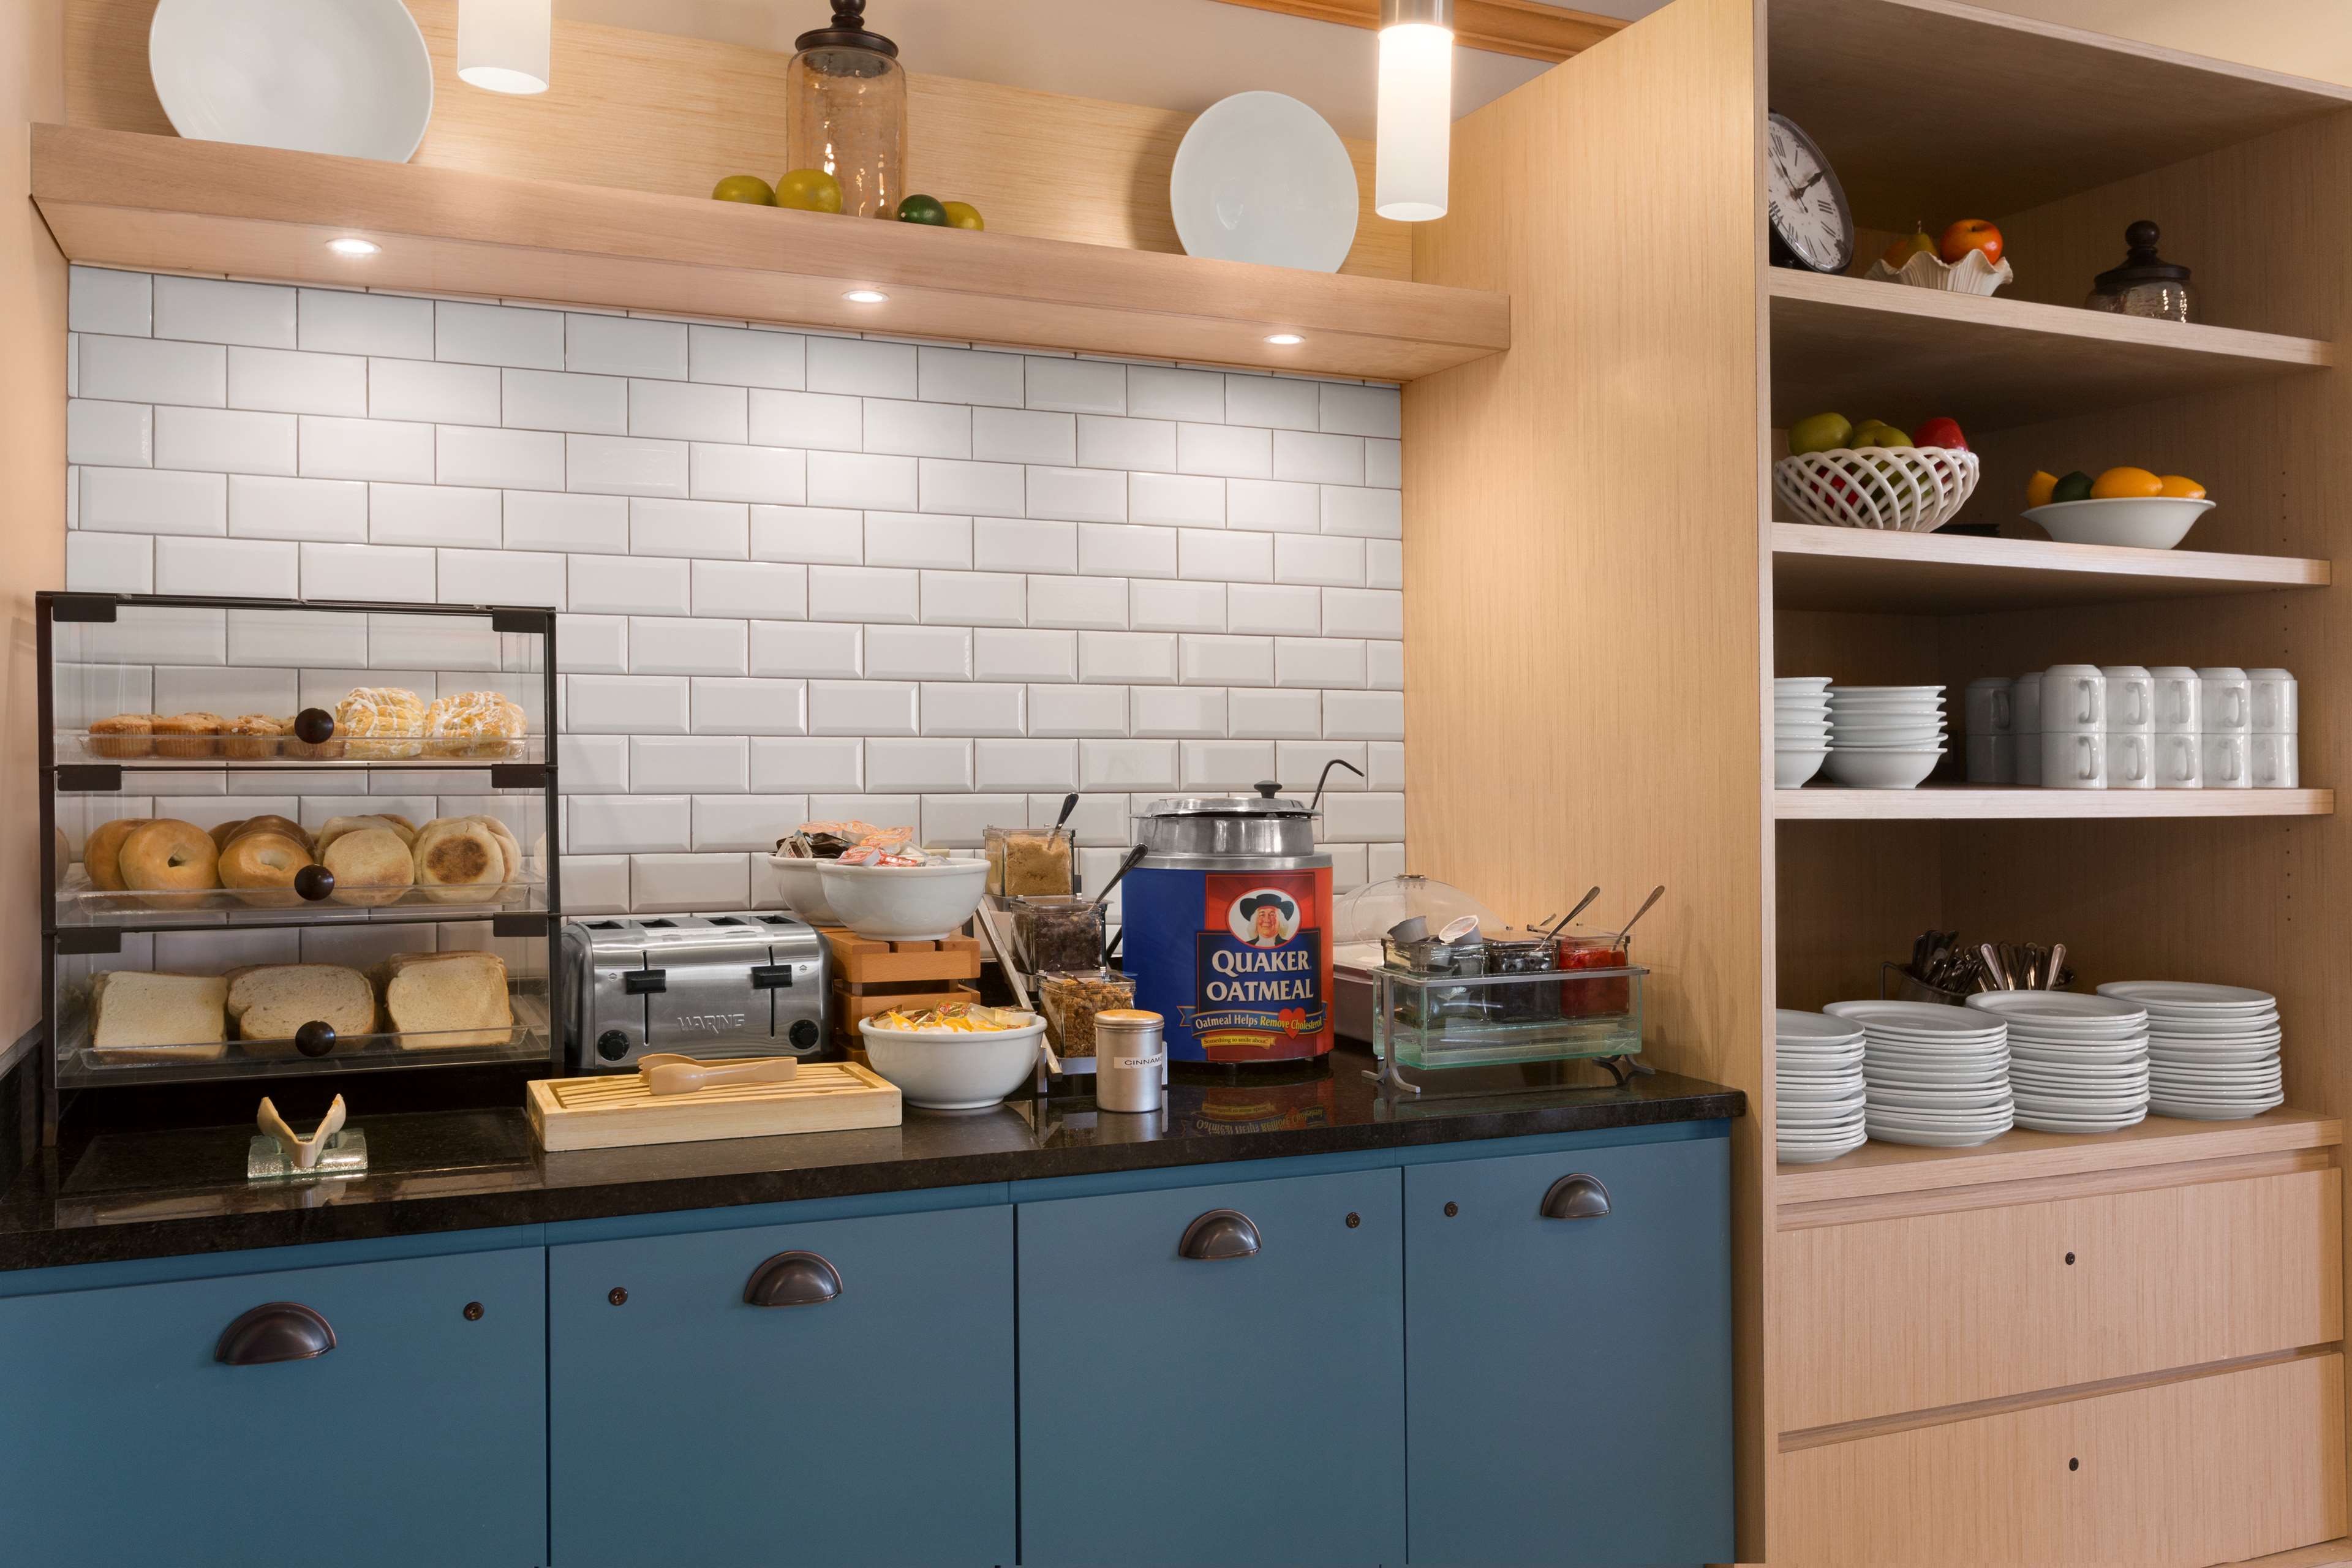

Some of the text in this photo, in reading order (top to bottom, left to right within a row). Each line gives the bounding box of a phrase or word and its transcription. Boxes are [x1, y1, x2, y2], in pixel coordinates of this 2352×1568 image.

[1212, 950, 1310, 978] QUAKER
[1206, 979, 1314, 1001] OATMEAL
[677, 1014, 745, 1034] WARING
[1196, 1014, 1322, 1030] Oatmeal Helps Remove Cholesterol
[1125, 1056, 1162, 1066] CINNAM
